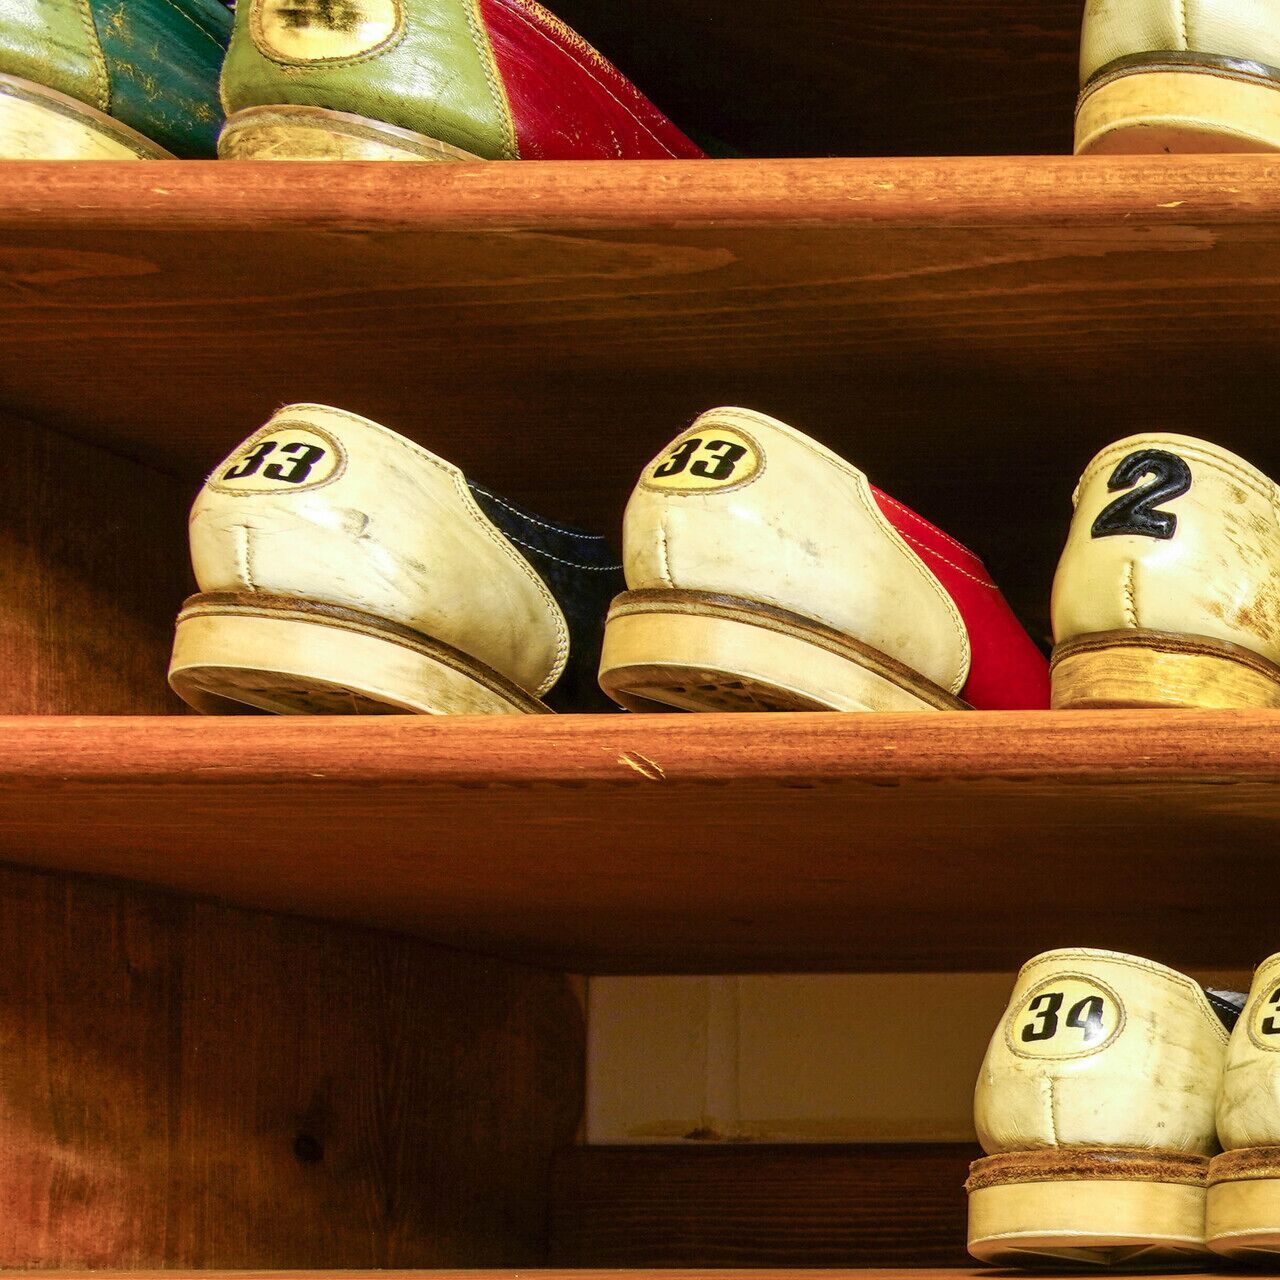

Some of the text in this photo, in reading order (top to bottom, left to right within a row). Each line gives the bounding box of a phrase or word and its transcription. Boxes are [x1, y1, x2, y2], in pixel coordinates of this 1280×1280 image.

[223, 440, 327, 484] 33
[653, 438, 747, 480] 33
[1091, 449, 1191, 539] 2
[1020, 992, 1105, 1041] 34
